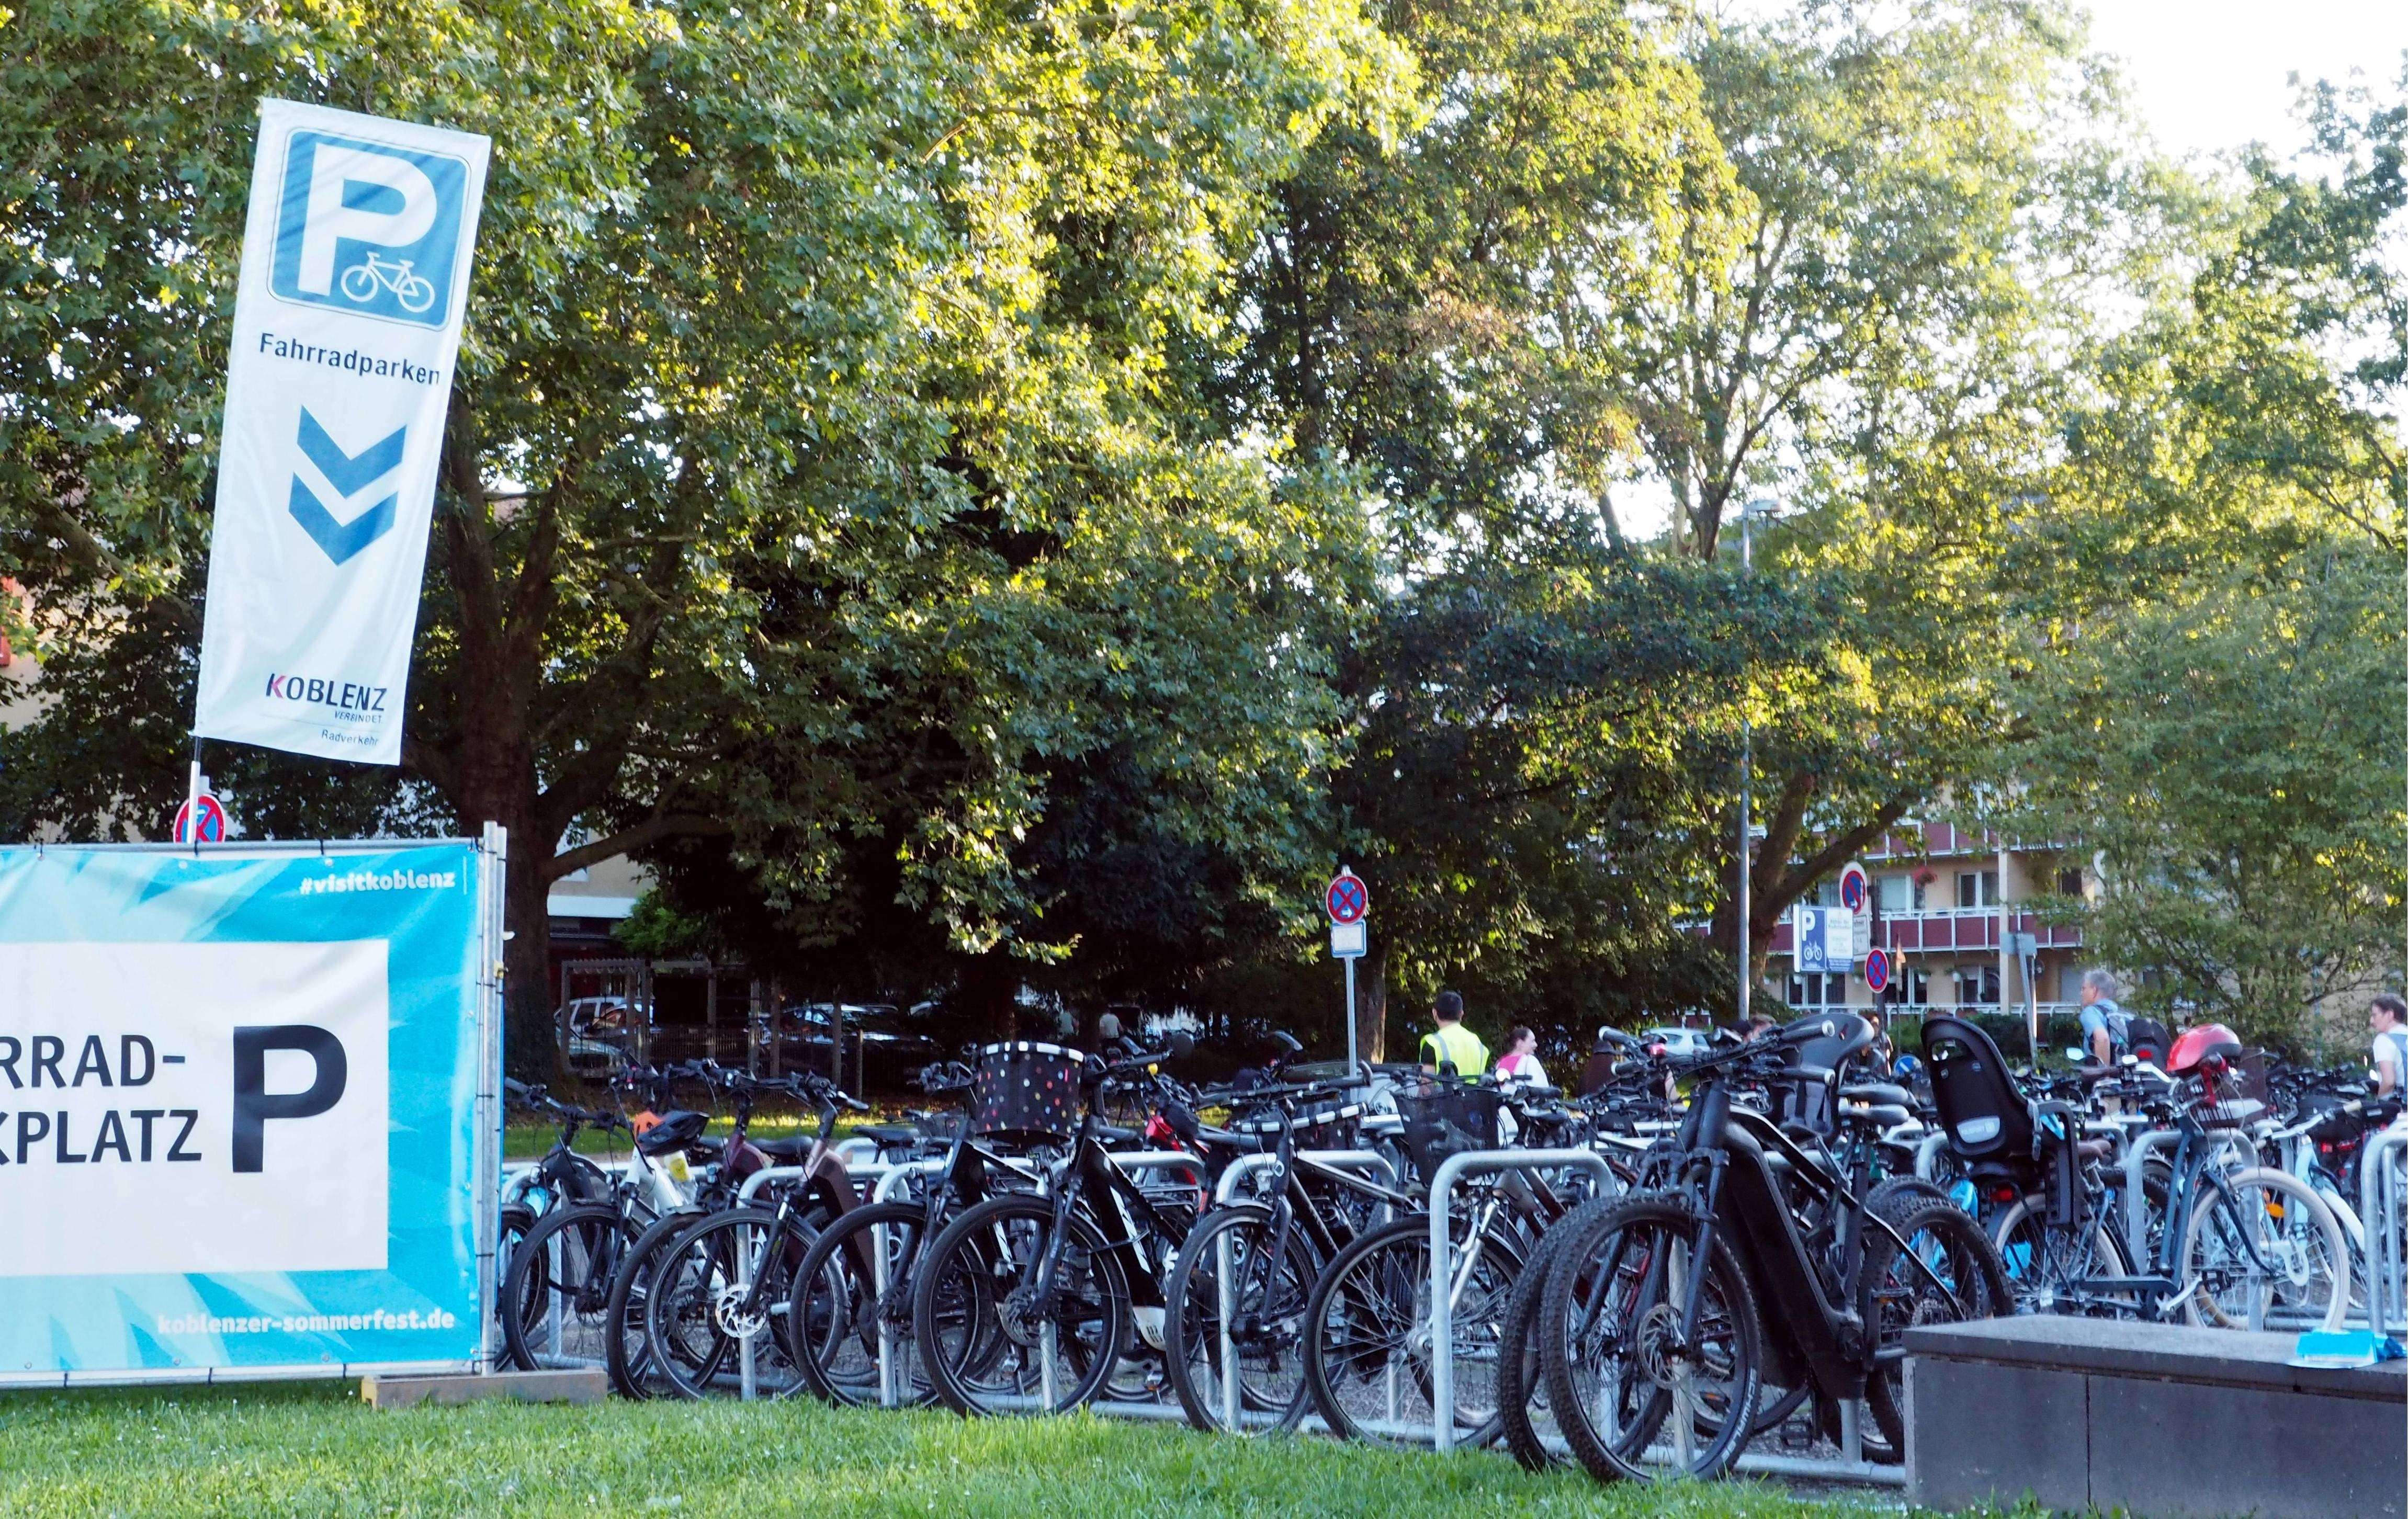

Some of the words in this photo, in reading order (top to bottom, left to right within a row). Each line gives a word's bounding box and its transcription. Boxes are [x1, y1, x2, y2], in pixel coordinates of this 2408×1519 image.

[297, 142, 437, 296] P
[260, 333, 439, 385] Fahrradparken
[266, 673, 387, 711] KOBLENZ
[322, 728, 379, 746] Radverkehr
[299, 868, 456, 895] #visitkoblenz
[1802, 910, 1815, 941] P
[0, 1035, 185, 1089] RRAD-
[233, 1025, 347, 1173] P
[158, 1308, 455, 1334] koblenzer-sommerfest.de
